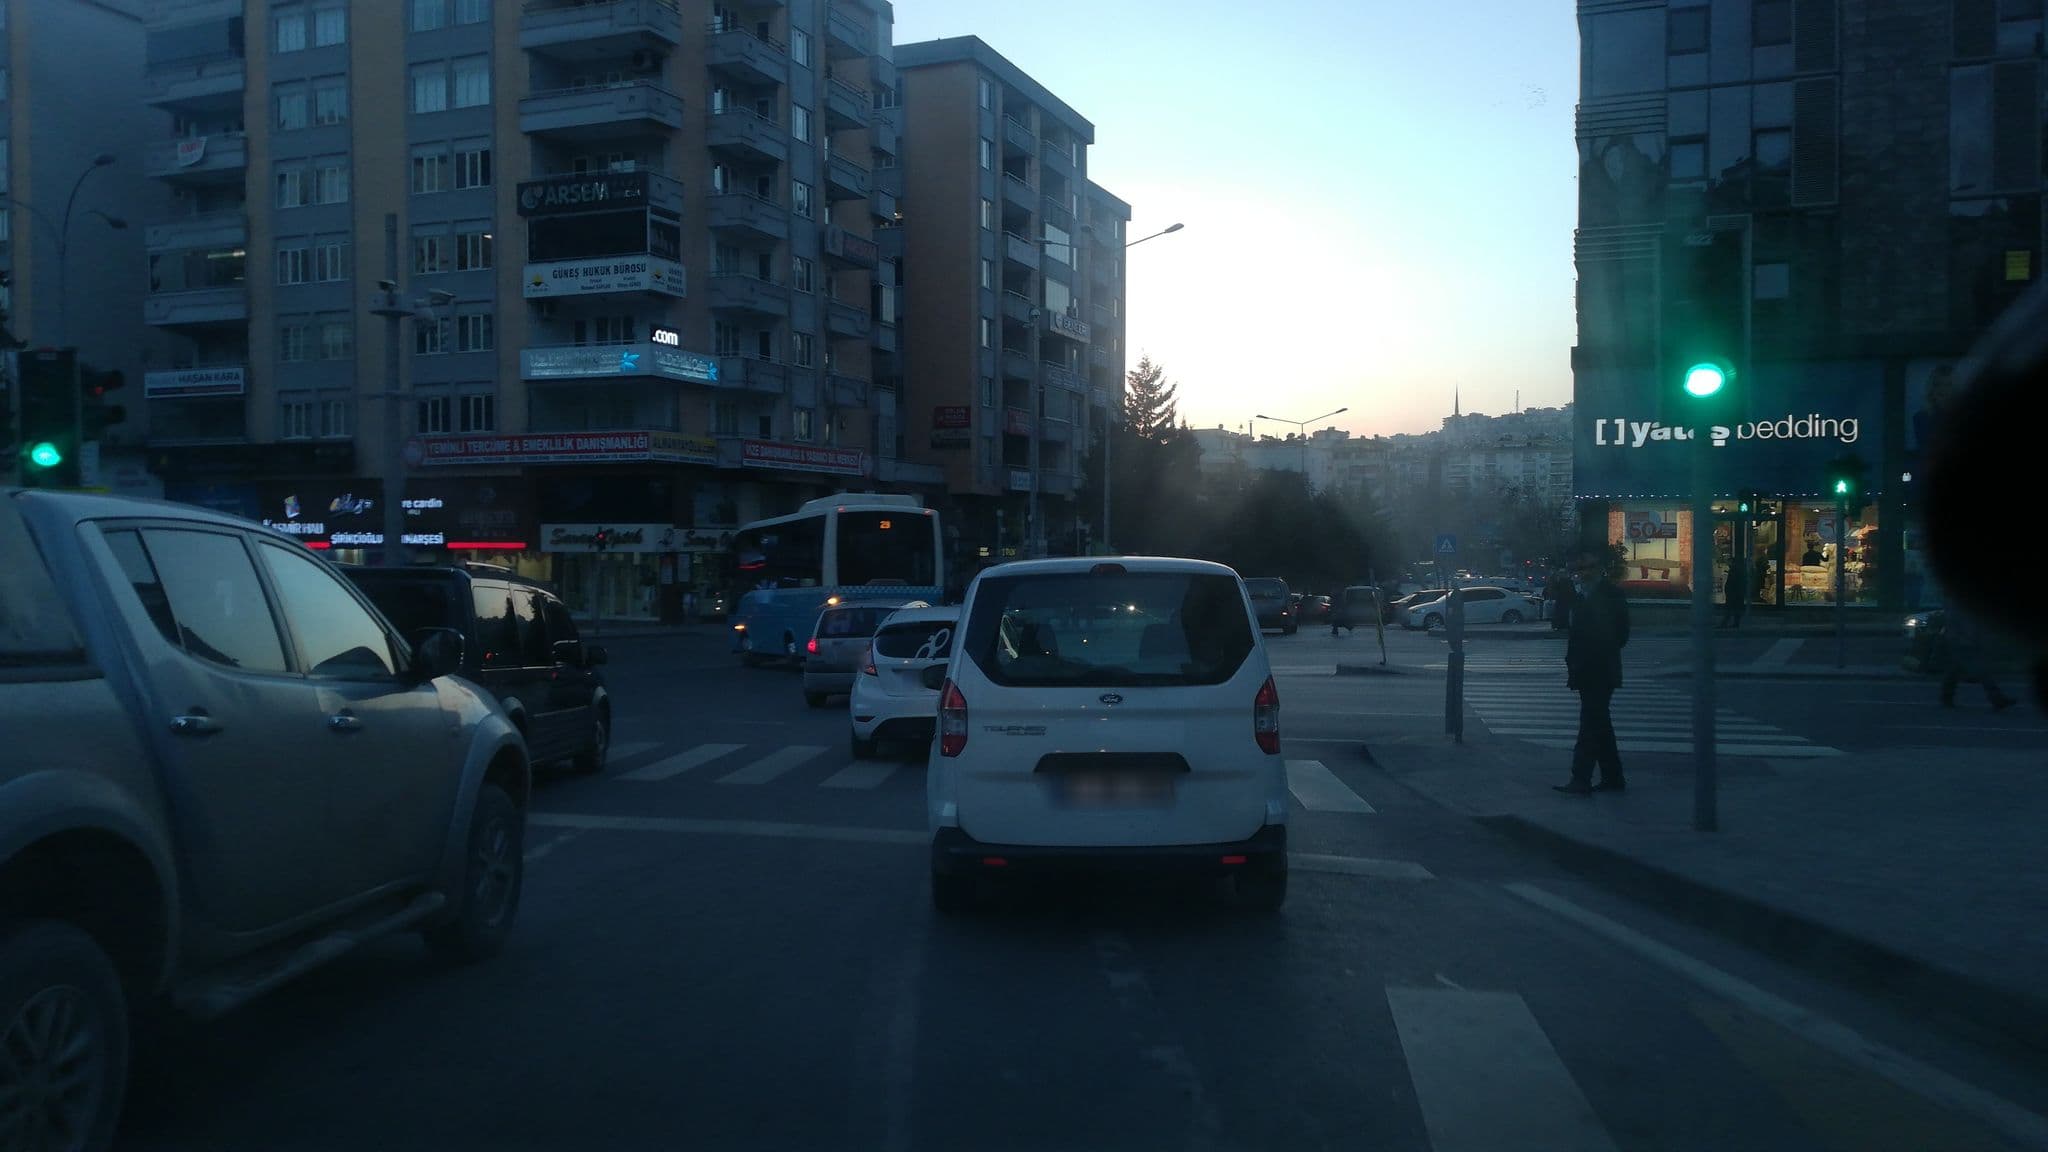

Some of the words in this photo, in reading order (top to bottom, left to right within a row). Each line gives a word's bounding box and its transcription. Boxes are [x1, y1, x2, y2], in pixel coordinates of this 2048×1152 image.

[552, 267, 579, 280] GÜNEŞ
[583, 265, 611, 278] HUKUK
[613, 262, 646, 275] BÜROSU
[652, 329, 679, 346] .com
[213, 371, 240, 382] KARA
[1631, 421, 1730, 447] yatş
[1737, 413, 1859, 444] bedding
[576, 434, 648, 451] DANIŞMANLIĞI
